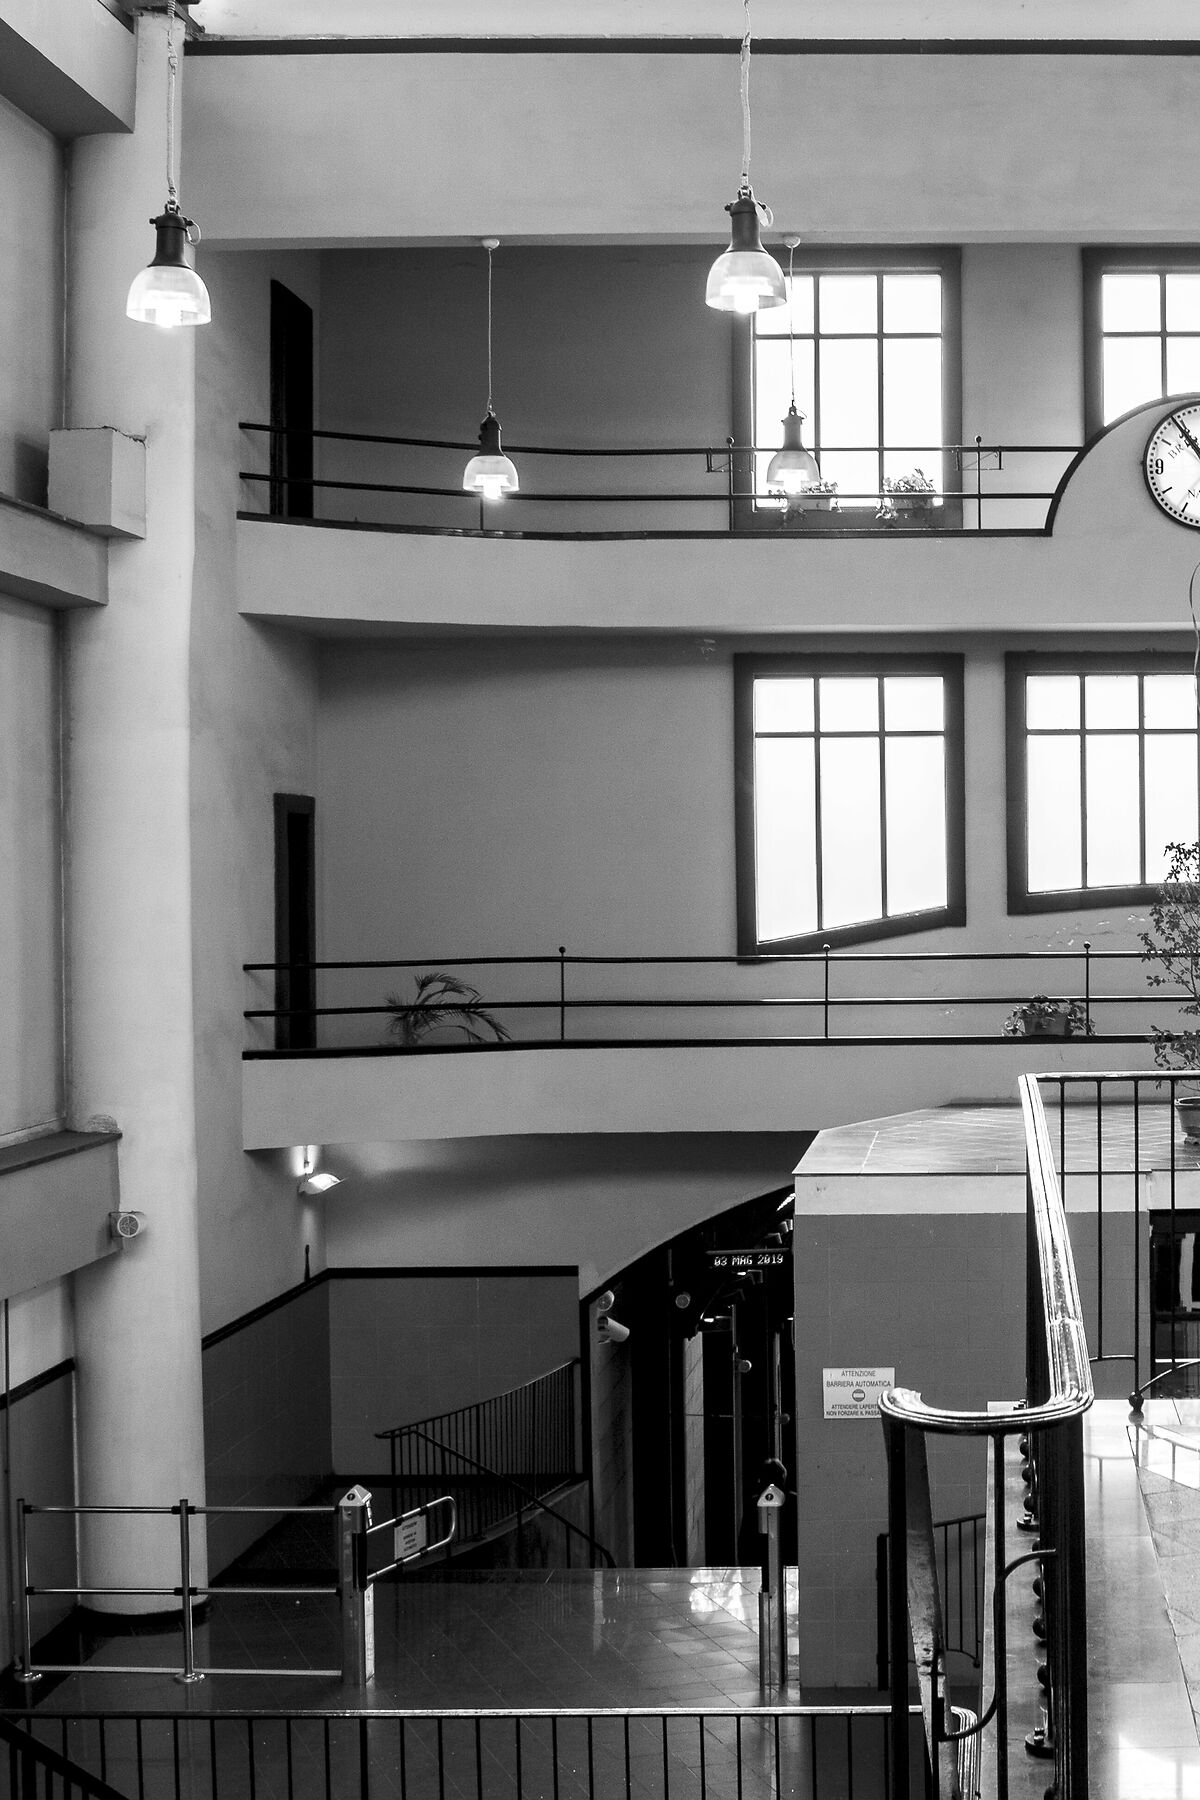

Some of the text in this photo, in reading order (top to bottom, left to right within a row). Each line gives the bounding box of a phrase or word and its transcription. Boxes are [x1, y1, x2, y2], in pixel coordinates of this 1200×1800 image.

[1155, 458, 1164, 475] 9
[714, 1253, 784, 1267] 03 MAG 2019
